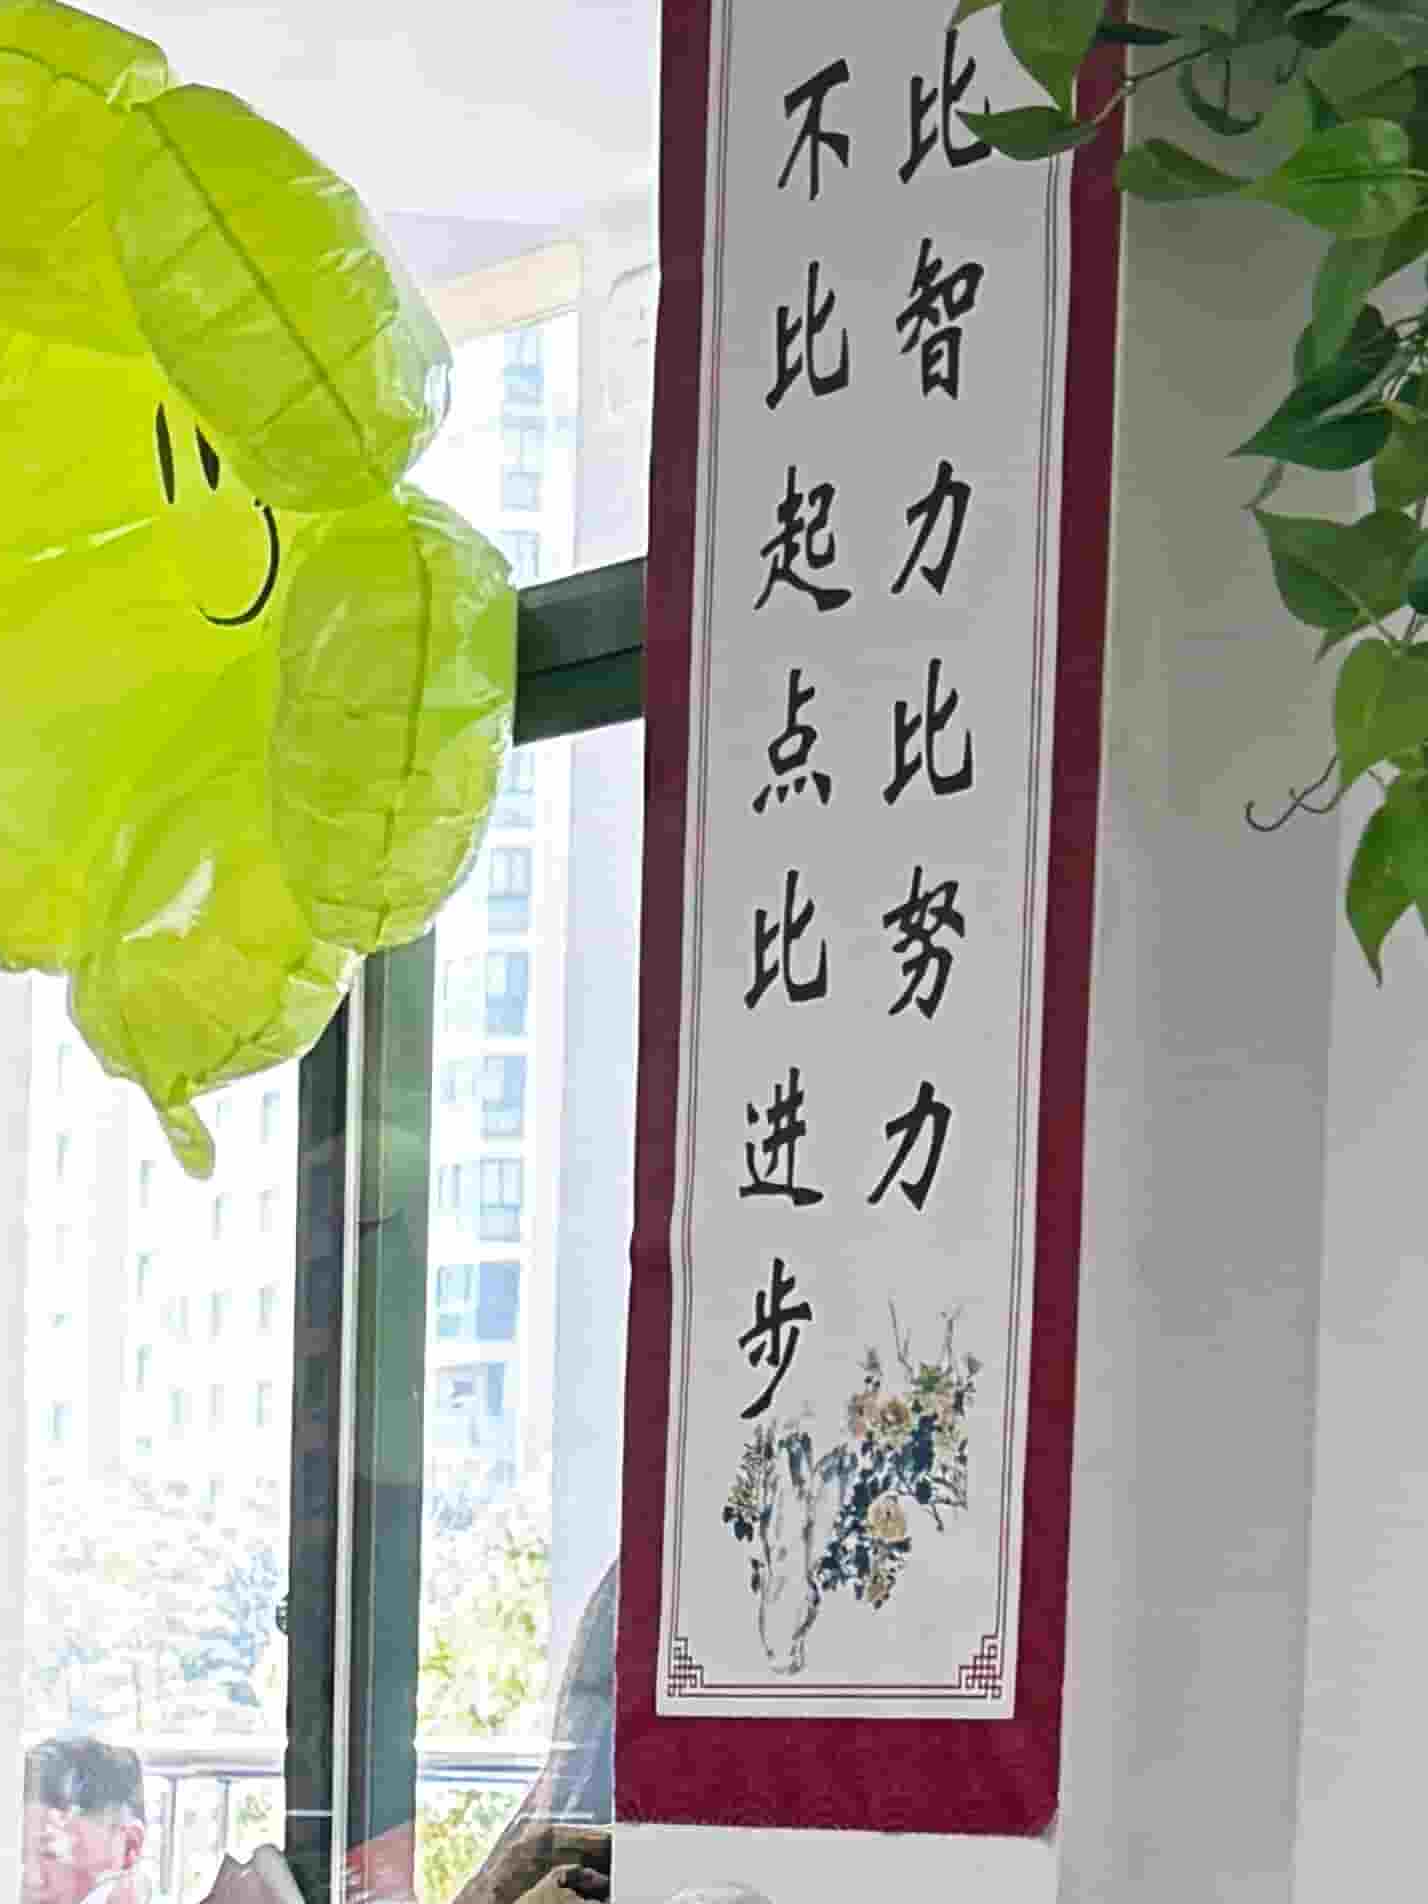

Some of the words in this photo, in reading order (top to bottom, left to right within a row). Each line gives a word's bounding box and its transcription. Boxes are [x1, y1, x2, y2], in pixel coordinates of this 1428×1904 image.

[736, 59, 853, 1421] 不比起点比进步
